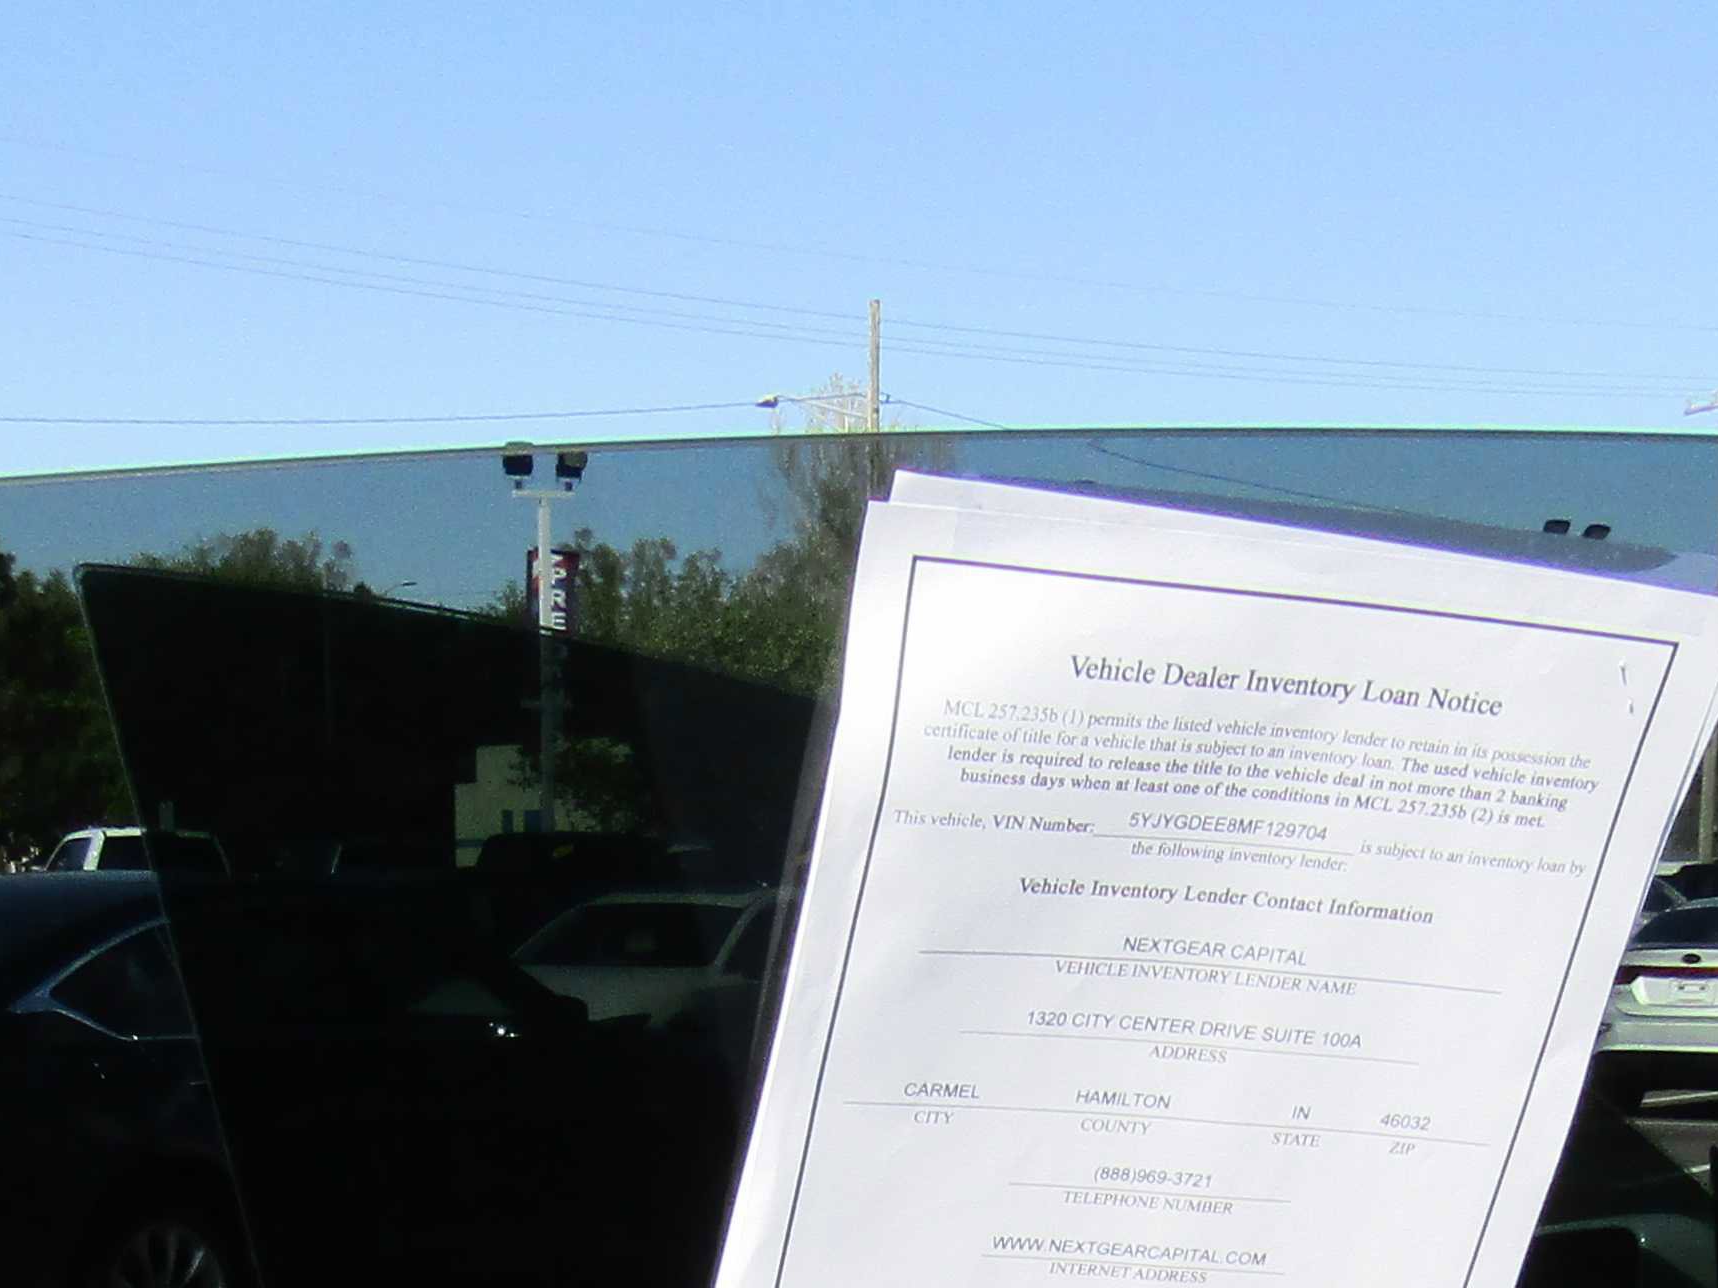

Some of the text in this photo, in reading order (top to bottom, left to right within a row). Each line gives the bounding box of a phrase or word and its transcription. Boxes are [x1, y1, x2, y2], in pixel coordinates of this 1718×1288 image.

[1070, 654, 1503, 716] Vehicle Dealer Inventory Loan Notice
[943, 698, 985, 718] MCL
[1061, 708, 1085, 728] (1)
[1085, 712, 1143, 729] permits
[1145, 713, 1170, 730] the
[1171, 714, 1213, 733] listed
[1215, 718, 1267, 737] vehicle
[1268, 721, 1339, 746] inventory
[1341, 728, 1389, 748] lender
[1389, 736, 1406, 750] to
[1407, 738, 1450, 755] retain
[1452, 740, 1468, 757] in
[1470, 742, 1489, 759] its
[1489, 749, 1567, 767] possession
[1568, 753, 1591, 769] the
[923, 722, 999, 742] certificate
[1001, 726, 1023, 743] of
[1022, 727, 1052, 745] title
[1055, 729, 1079, 746] for
[1079, 734, 1090, 747] a
[1093, 731, 1147, 751] vehicle
[1148, 735, 1178, 753] that
[1179, 736, 1193, 753] is
[1194, 738, 1248, 759] subject
[1249, 743, 1265, 758] to
[1266, 746, 1285, 759] an
[1288, 744, 1358, 769] inventory
[1400, 756, 1430, 774] The
[1432, 762, 1470, 778] used
[1472, 765, 1527, 784] vehicle
[1529, 769, 1599, 794] inventory
[947, 744, 998, 763] lender
[1000, 747, 1015, 764] is
[1018, 750, 1085, 769] required
[1087, 754, 1104, 769] to
[1106, 754, 1161, 773] release
[1164, 757, 1189, 774] the
[1191, 758, 1223, 776] title
[1225, 762, 1243, 777] to
[1245, 762, 1270, 779] the
[1274, 765, 1329, 784] vehicle
[1368, 773, 1385, 790] in
[1387, 780, 1414, 793] not
[1415, 783, 1456, 798] more
[1458, 783, 1492, 801] than
[1495, 788, 1507, 803] 2
[1509, 789, 1568, 812] banking
[959, 766, 1544, 827] business days when at least one of the conditions in MCL 257.235b (2) is met.
[894, 809, 1328, 840] This vehicle, VIN Number: 5YJYGDEE8MF129704
[1019, 876, 1433, 924] Vehicle Inventory Lender Contact Information
[1122, 935, 1307, 966] NEXTGEAR CAPITAL
[1055, 959, 1357, 995] VEHICLE INVENTORY LENDER NAME
[1027, 1010, 1361, 1048] 1320 CITY CENTER DRIVE SUITE 100A
[903, 1081, 1431, 1131] CARMEL HAMILTON IN 46032
[913, 1109, 1416, 1155] CITY COUNTY STATE ZIP
[1093, 1165, 1212, 1188] (888)969-3721
[1063, 1190, 1234, 1214] TELEPHONE NUMBER
[992, 1235, 1267, 1266] WWW.NEXTGEARCAPITAL.COM
[1049, 1261, 1208, 1284] INTERNET ADDRESS
